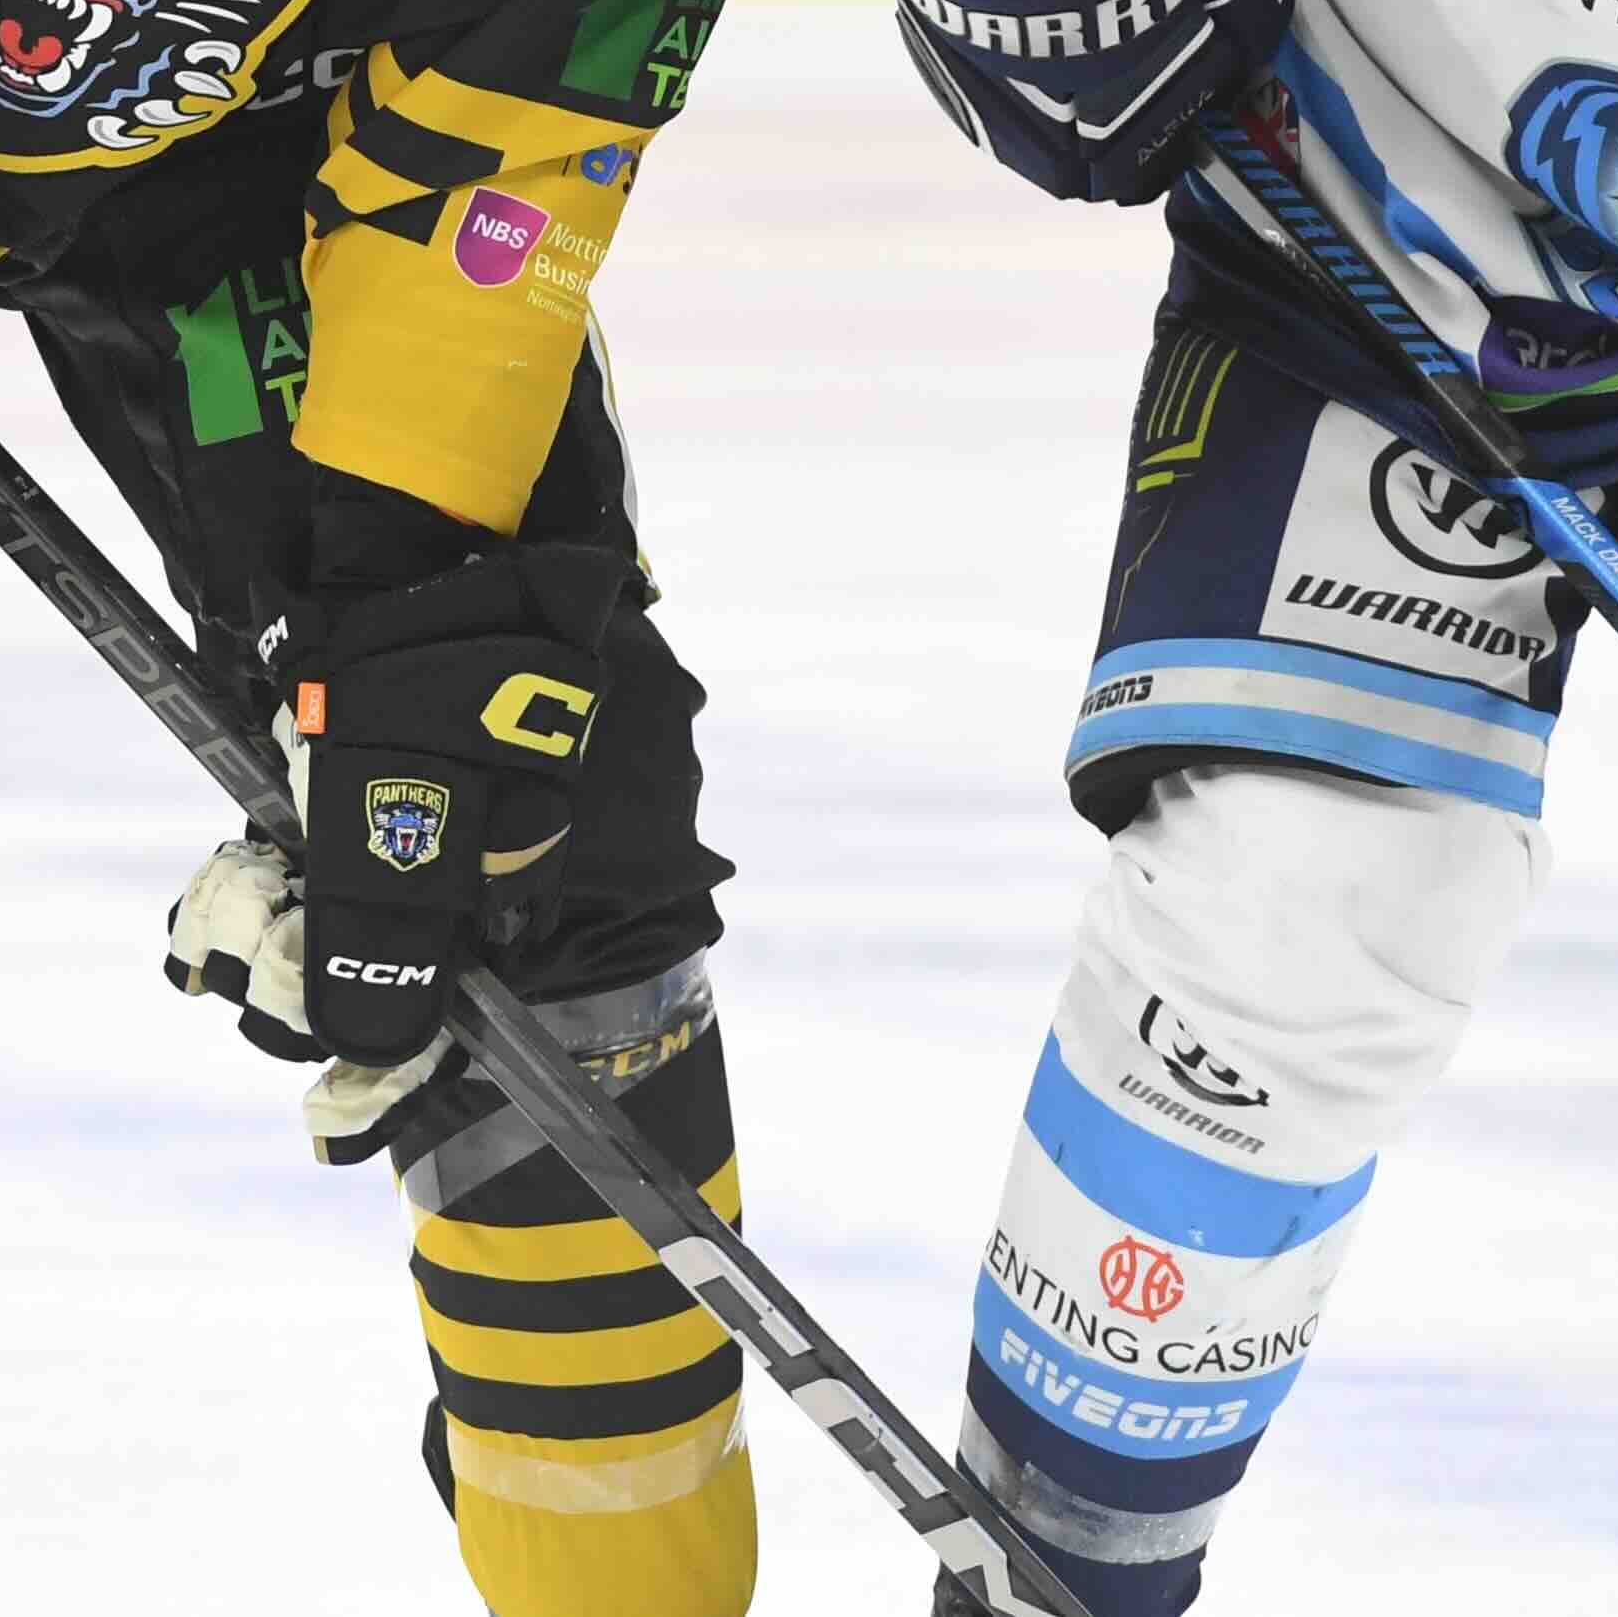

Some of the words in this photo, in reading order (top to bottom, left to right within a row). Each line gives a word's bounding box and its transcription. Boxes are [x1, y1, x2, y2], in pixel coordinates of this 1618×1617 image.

[472, 213, 529, 250] NBS
[1550, 495, 1605, 548] MACK
[1285, 573, 1547, 664] WARRIOR
[373, 784, 443, 812] PANTHERS
[326, 955, 437, 987] CCM
[1119, 1072, 1266, 1156] WARRIOR
[987, 1228, 1140, 1365] ENTING
